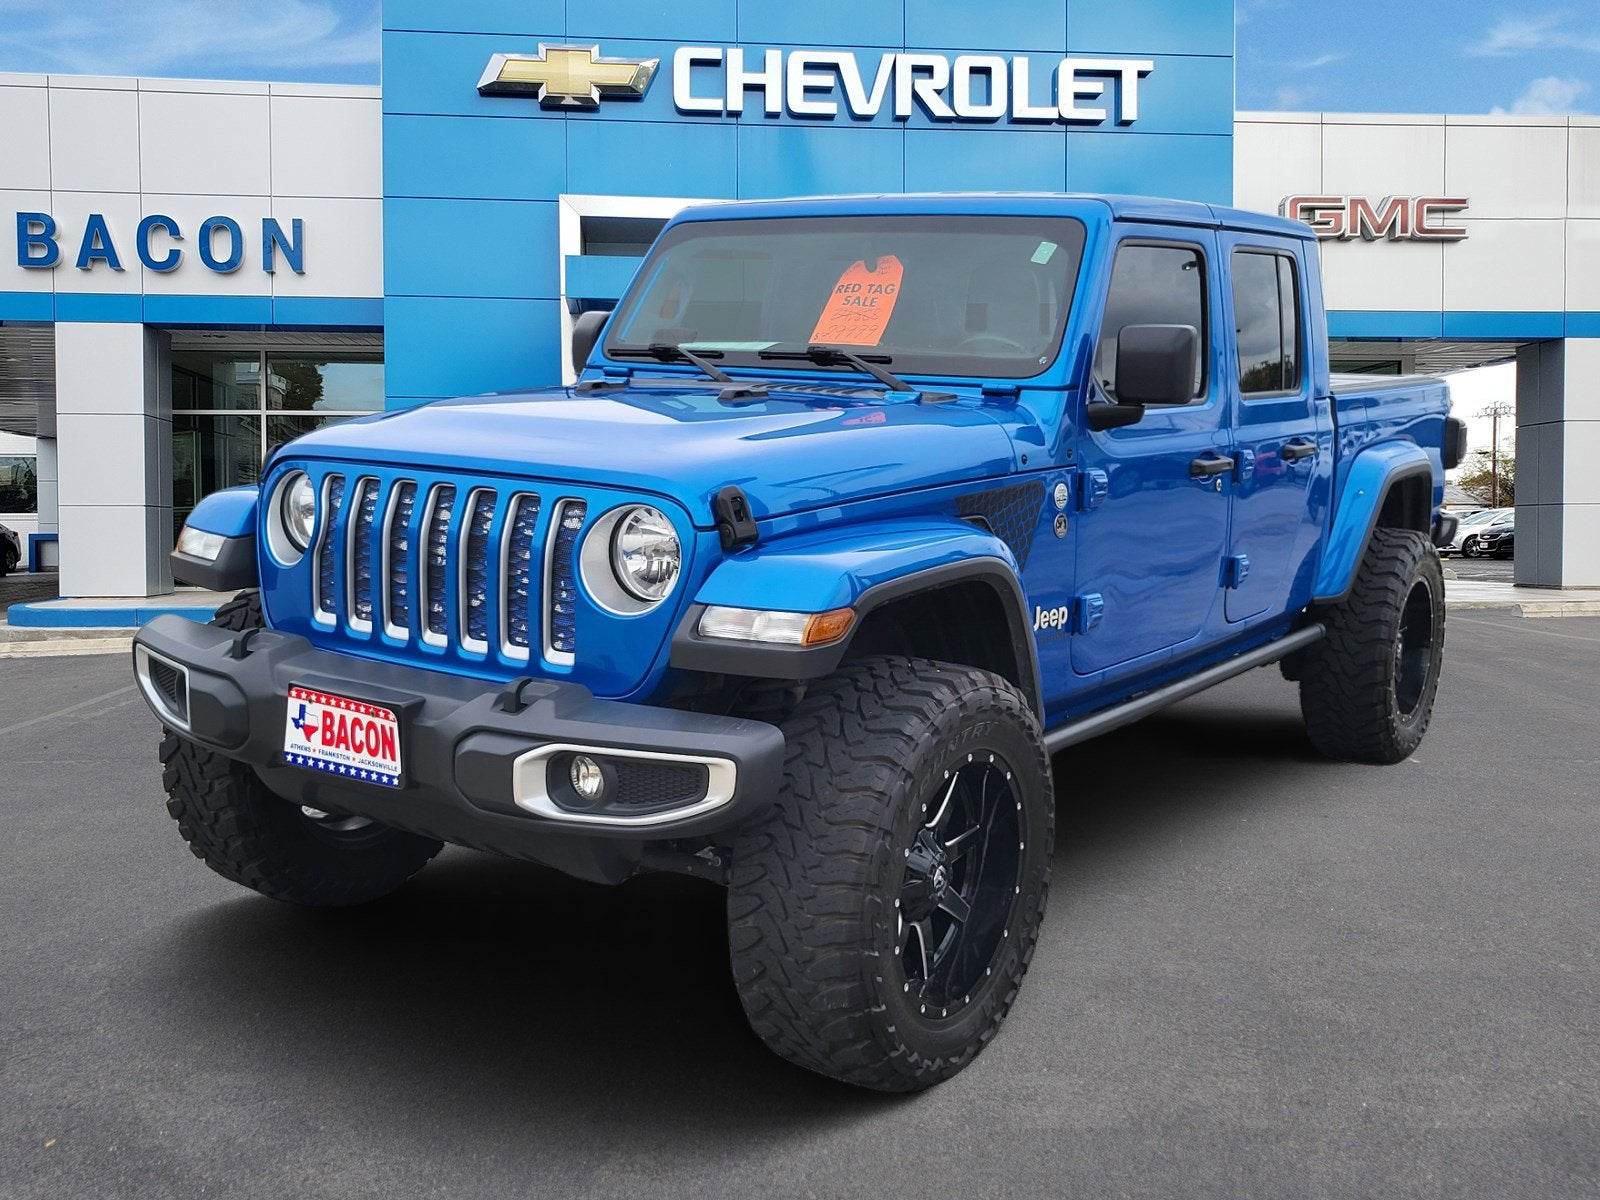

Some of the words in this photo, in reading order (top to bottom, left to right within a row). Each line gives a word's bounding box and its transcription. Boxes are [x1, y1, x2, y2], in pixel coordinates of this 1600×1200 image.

[672, 46, 1155, 126] CHEVROLET
[1279, 194, 1470, 242] GMC
[16, 211, 306, 275] BACON
[835, 283, 862, 295] RED
[867, 283, 896, 295] TAG
[842, 295, 878, 308] SALE
[1033, 605, 1068, 632] Jeep
[321, 710, 397, 762] BACON
[290, 743, 312, 753] ATHENS
[318, 748, 351, 762] FRANKSTON
[357, 757, 398, 772] JACKSONVILLE
